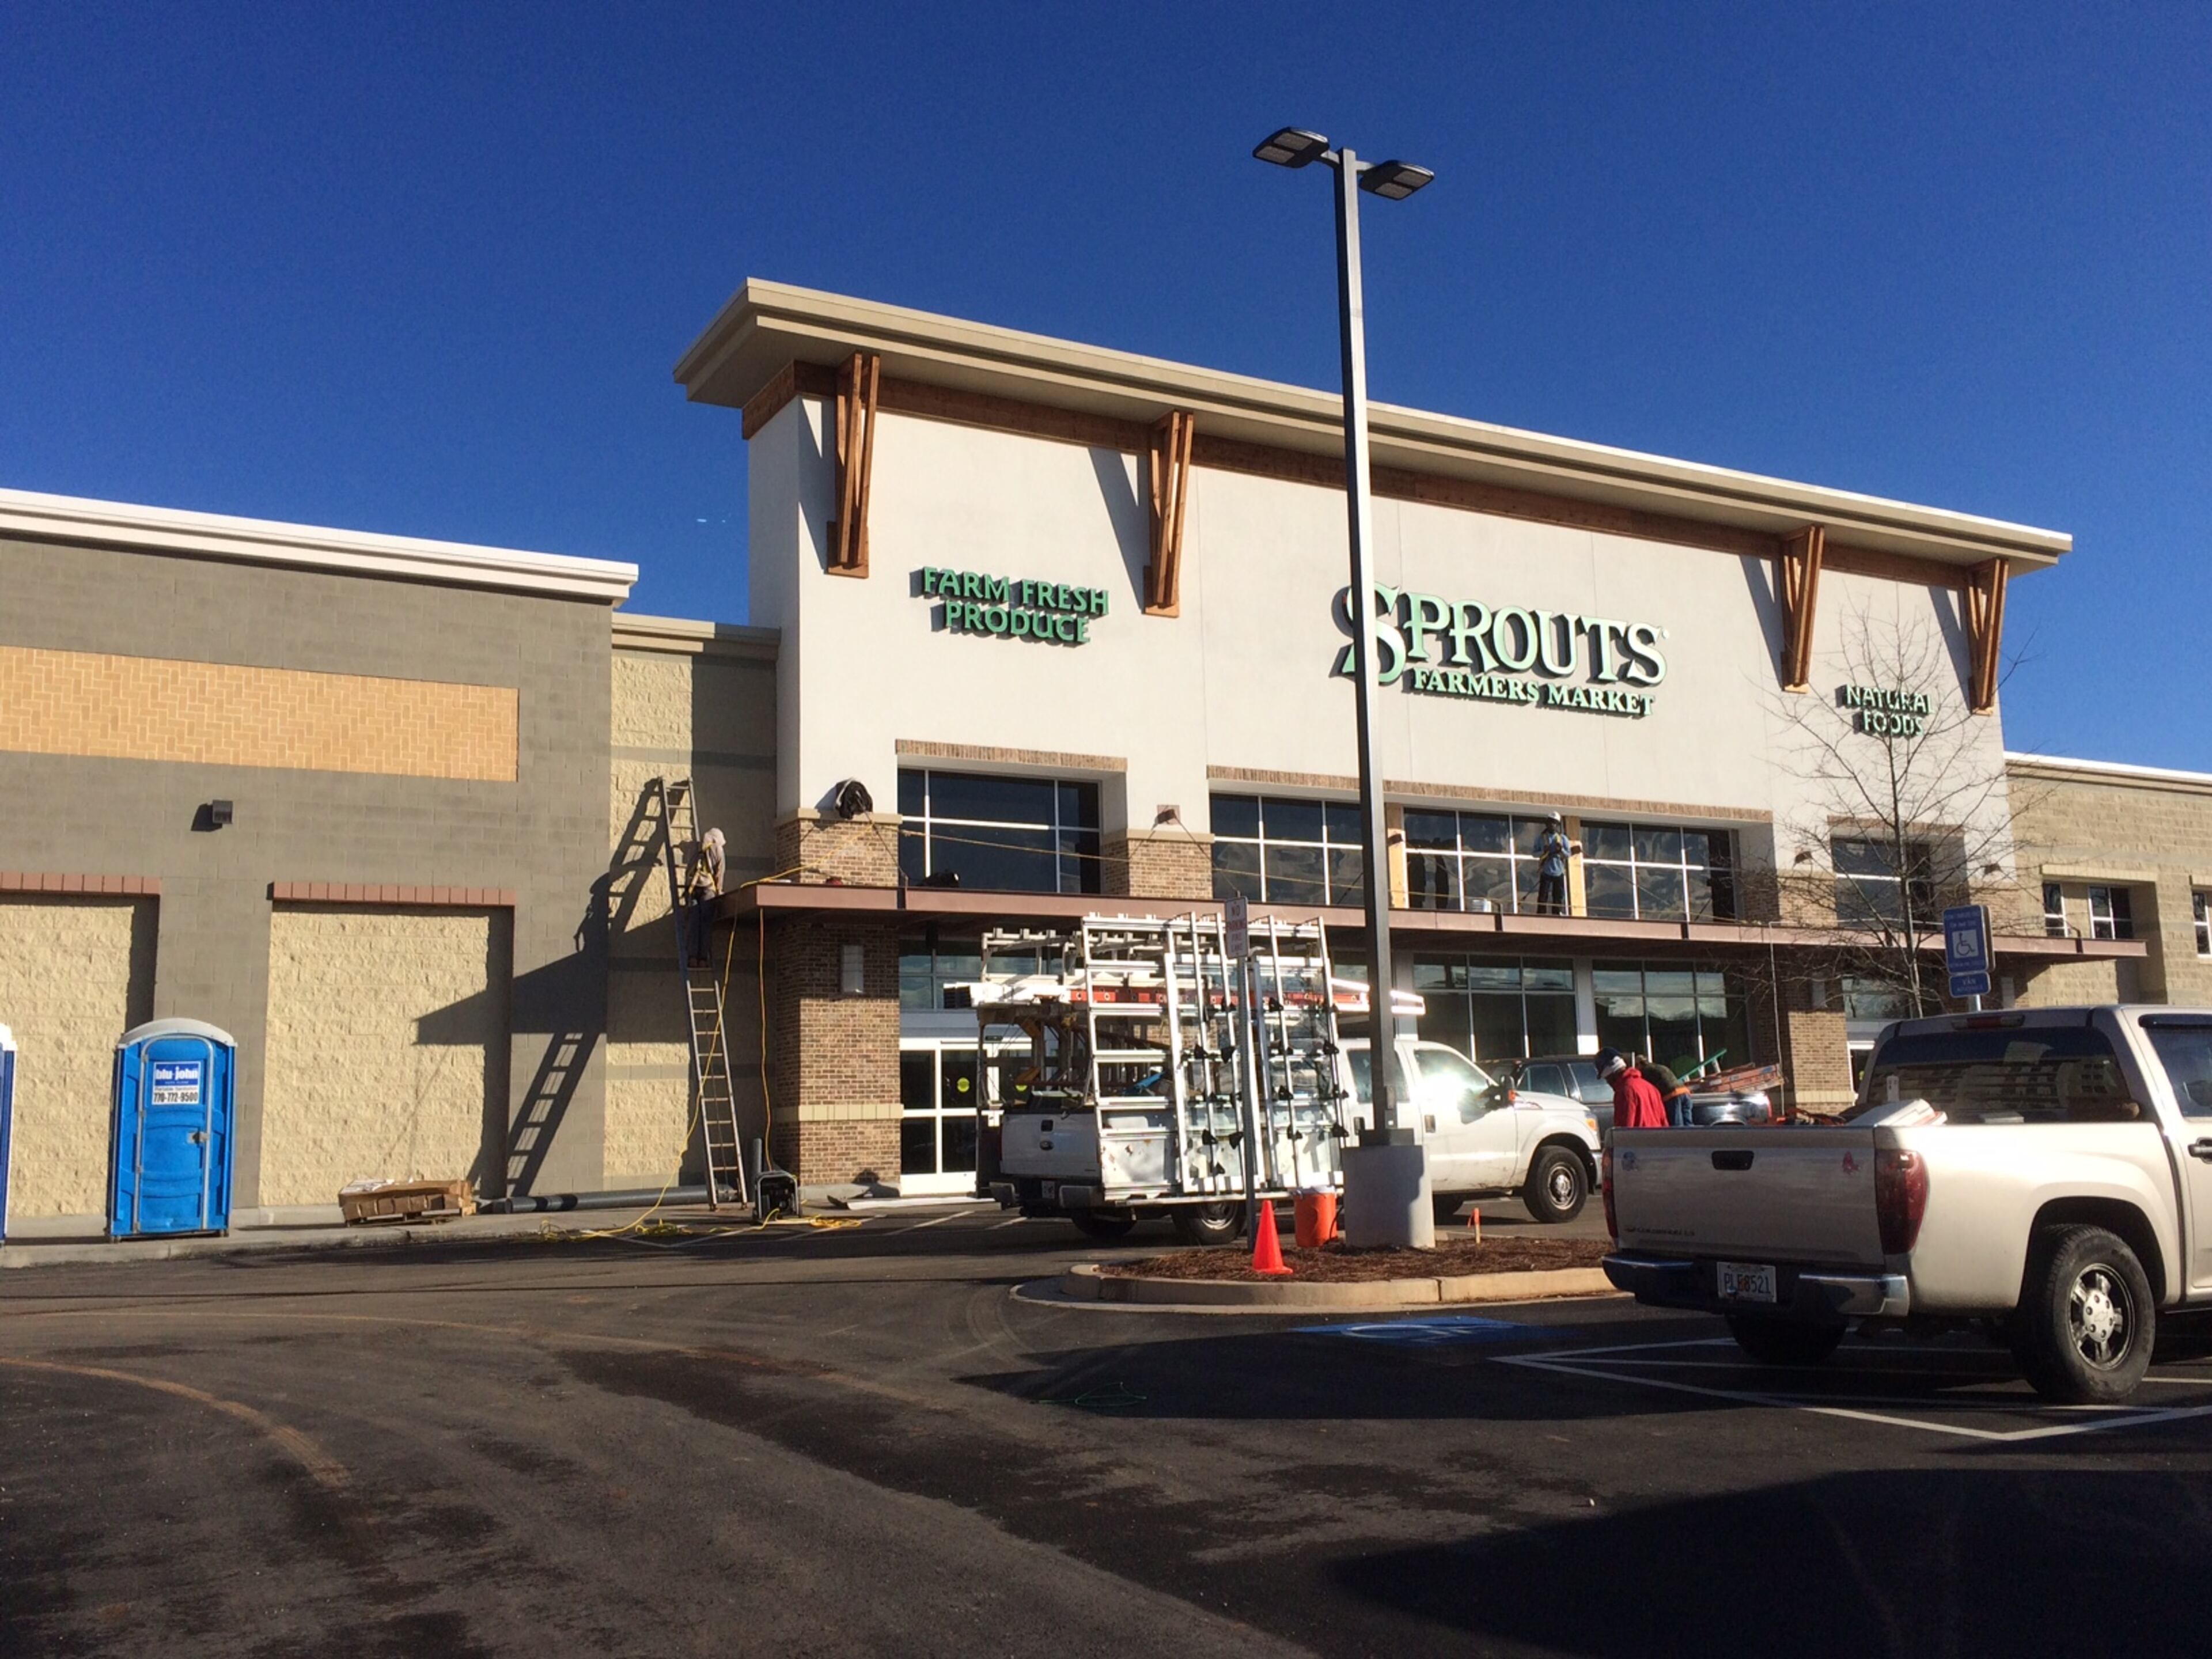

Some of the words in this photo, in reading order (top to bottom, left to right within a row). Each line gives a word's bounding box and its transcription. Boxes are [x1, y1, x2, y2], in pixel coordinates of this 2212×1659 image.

[922, 566, 1010, 603] FARM
[1021, 578, 1109, 615] FRESH
[945, 599, 1091, 643] PRODUCE
[1342, 581, 1668, 685] SPROUTS
[1412, 667, 1540, 703] FARMERS
[1547, 683, 1656, 717] MARKET
[1846, 684, 1936, 715] NATURAL
[1863, 709, 1925, 737] FOODS
